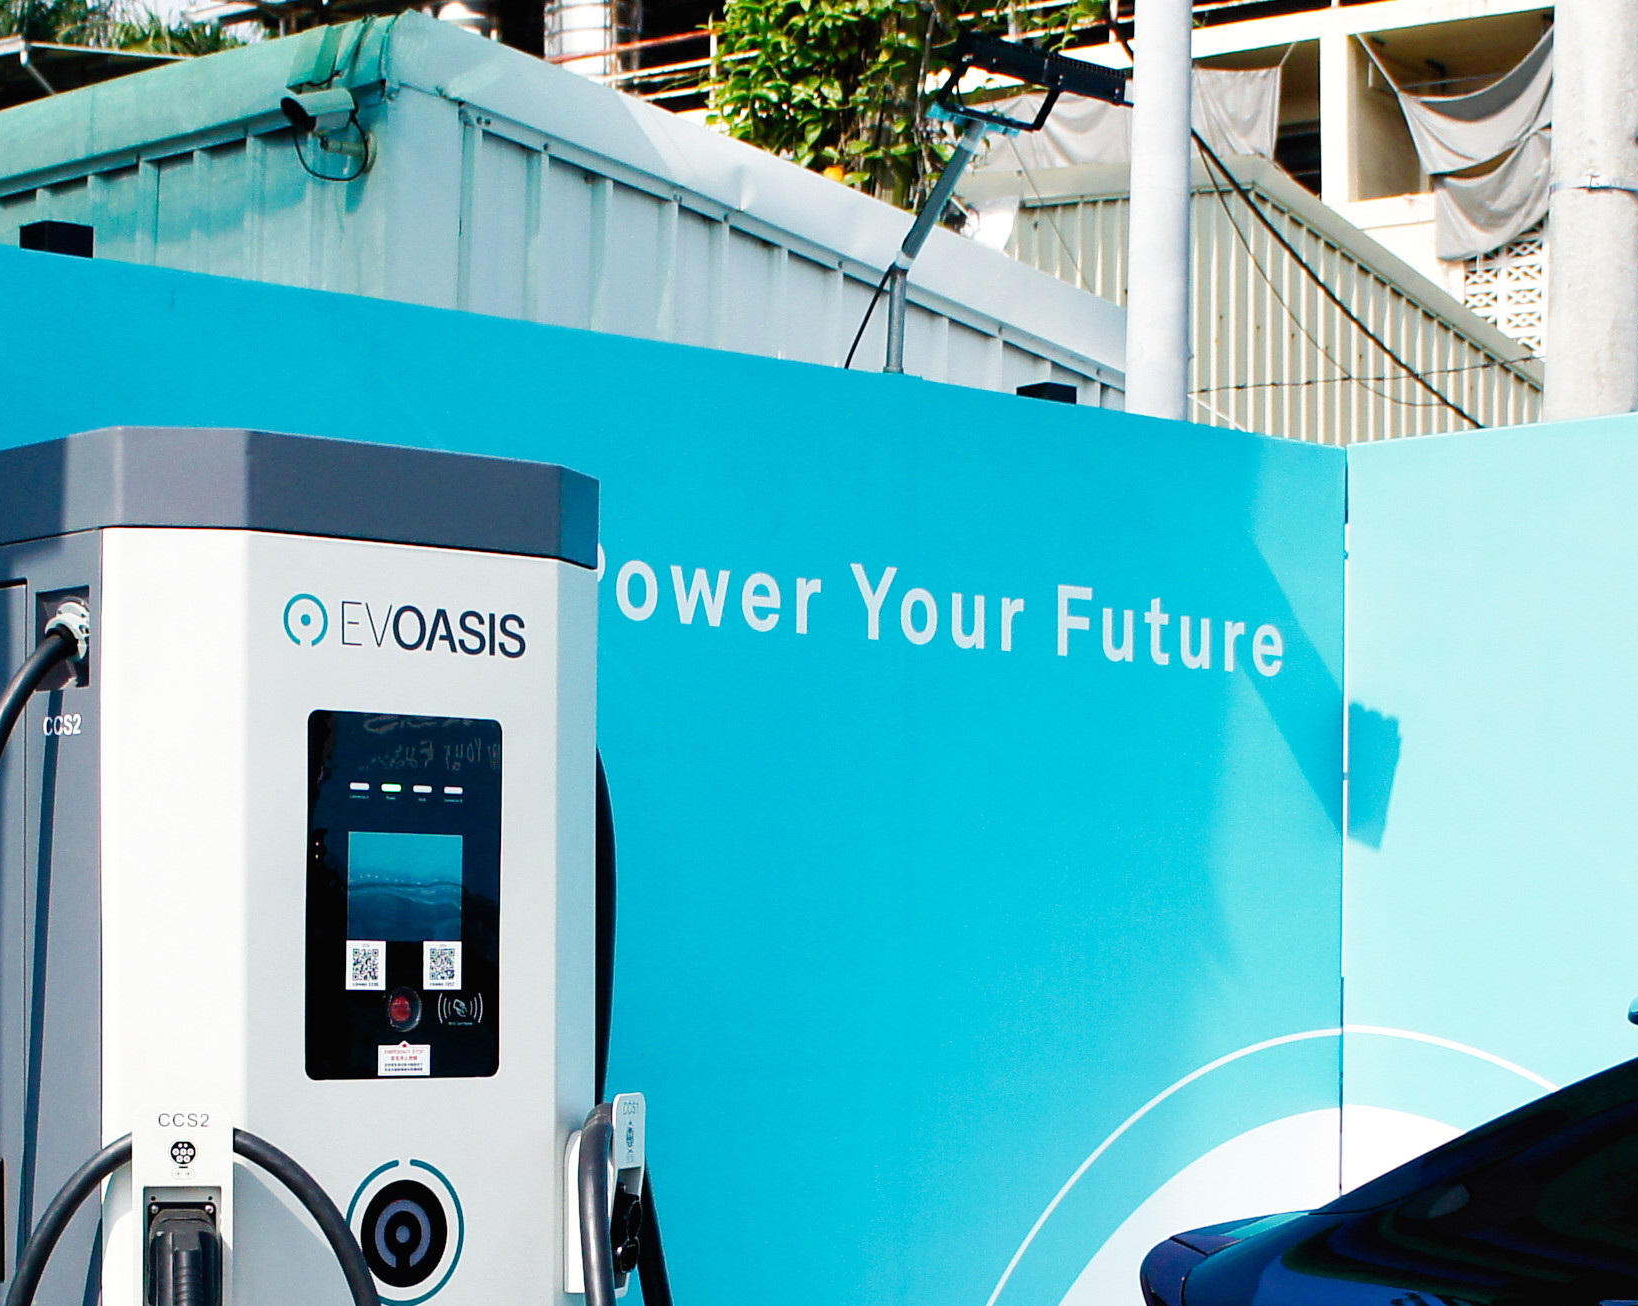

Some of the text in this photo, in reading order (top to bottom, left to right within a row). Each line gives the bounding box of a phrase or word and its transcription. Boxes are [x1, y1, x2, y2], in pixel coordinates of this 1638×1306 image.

[341, 600, 526, 658] EVOASIS
[597, 542, 1284, 677] ower Your Future
[43, 714, 81, 736] CCS2
[158, 1113, 210, 1128] CCS2
